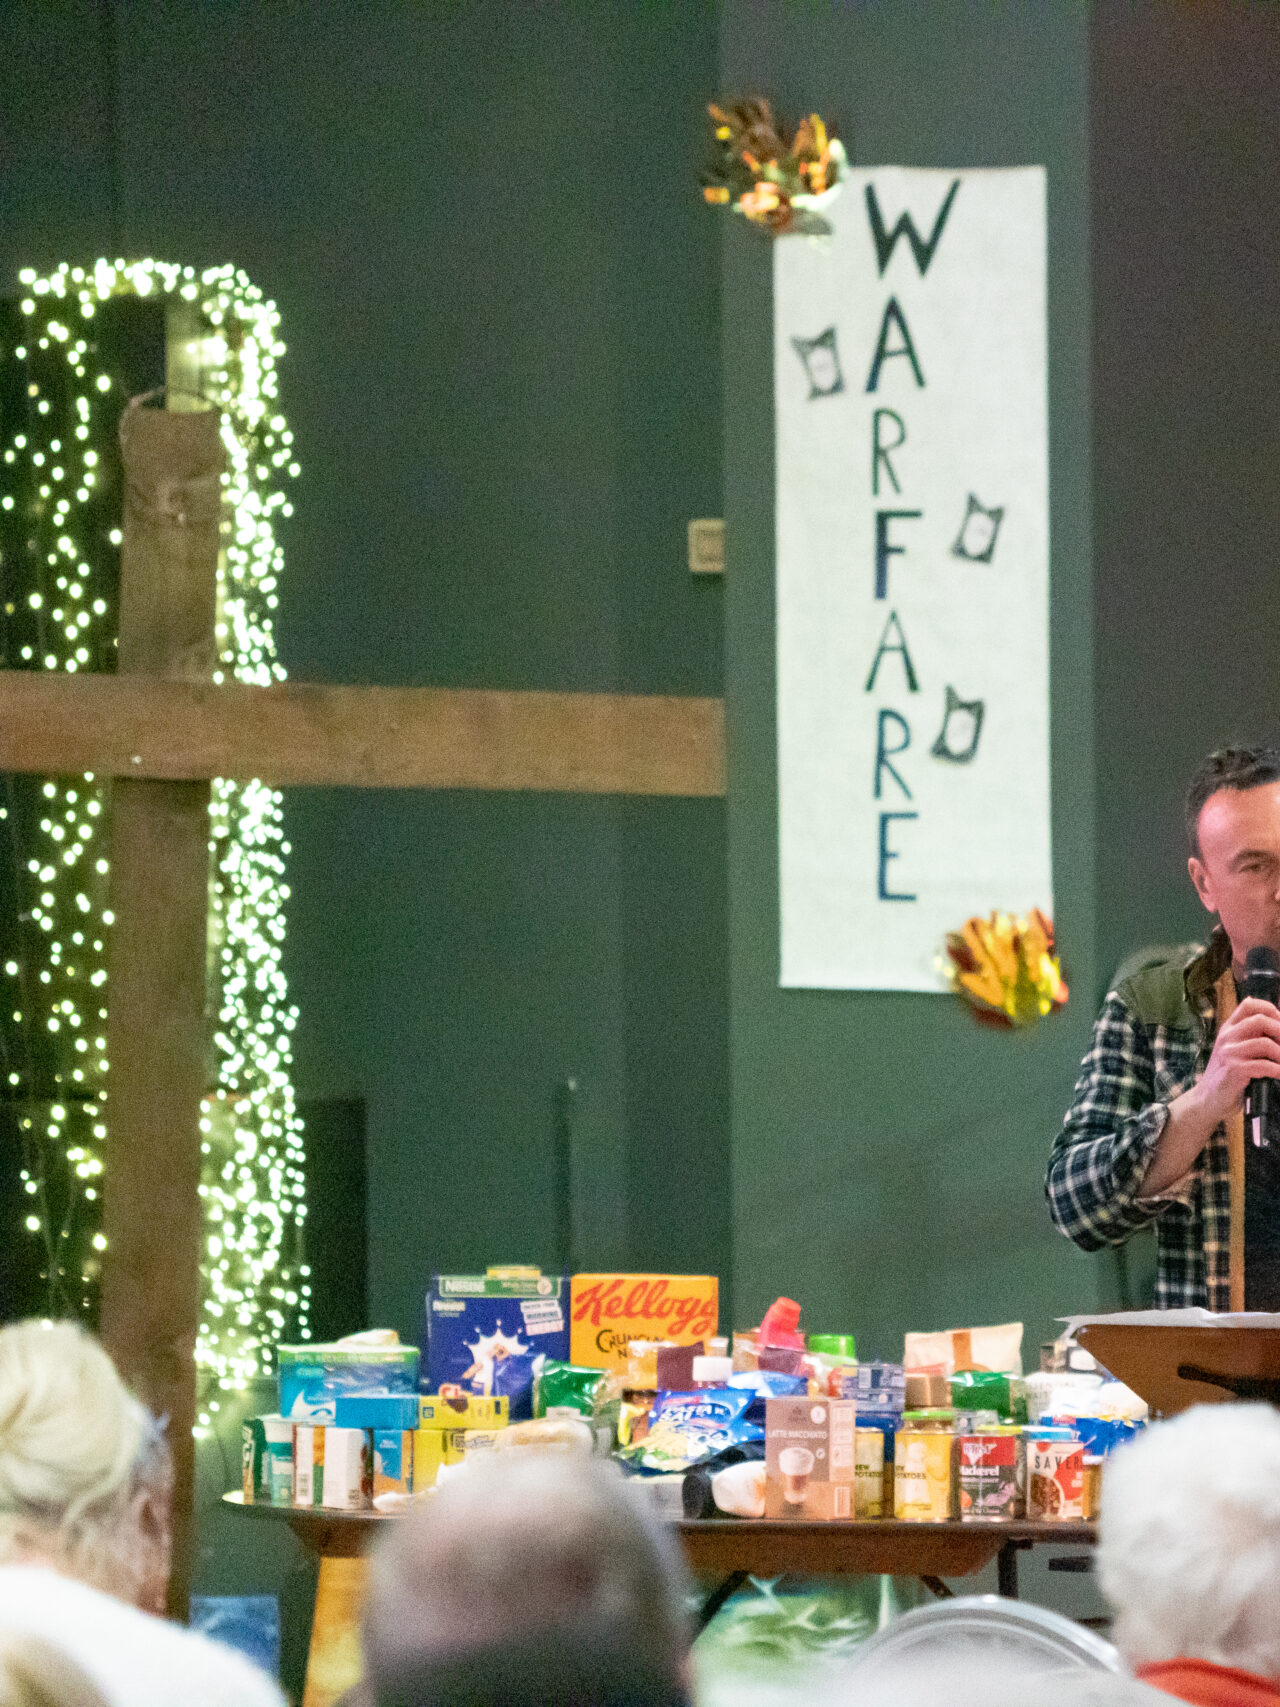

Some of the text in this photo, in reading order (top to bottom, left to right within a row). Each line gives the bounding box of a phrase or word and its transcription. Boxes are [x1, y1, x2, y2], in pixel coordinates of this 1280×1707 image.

[865, 177, 962, 902] WARFARE
[768, 1430, 828, 1439] LATTE MACCHIATO
[855, 1470, 883, 1478] POTATO
[895, 1471, 926, 1479] OTATOES
